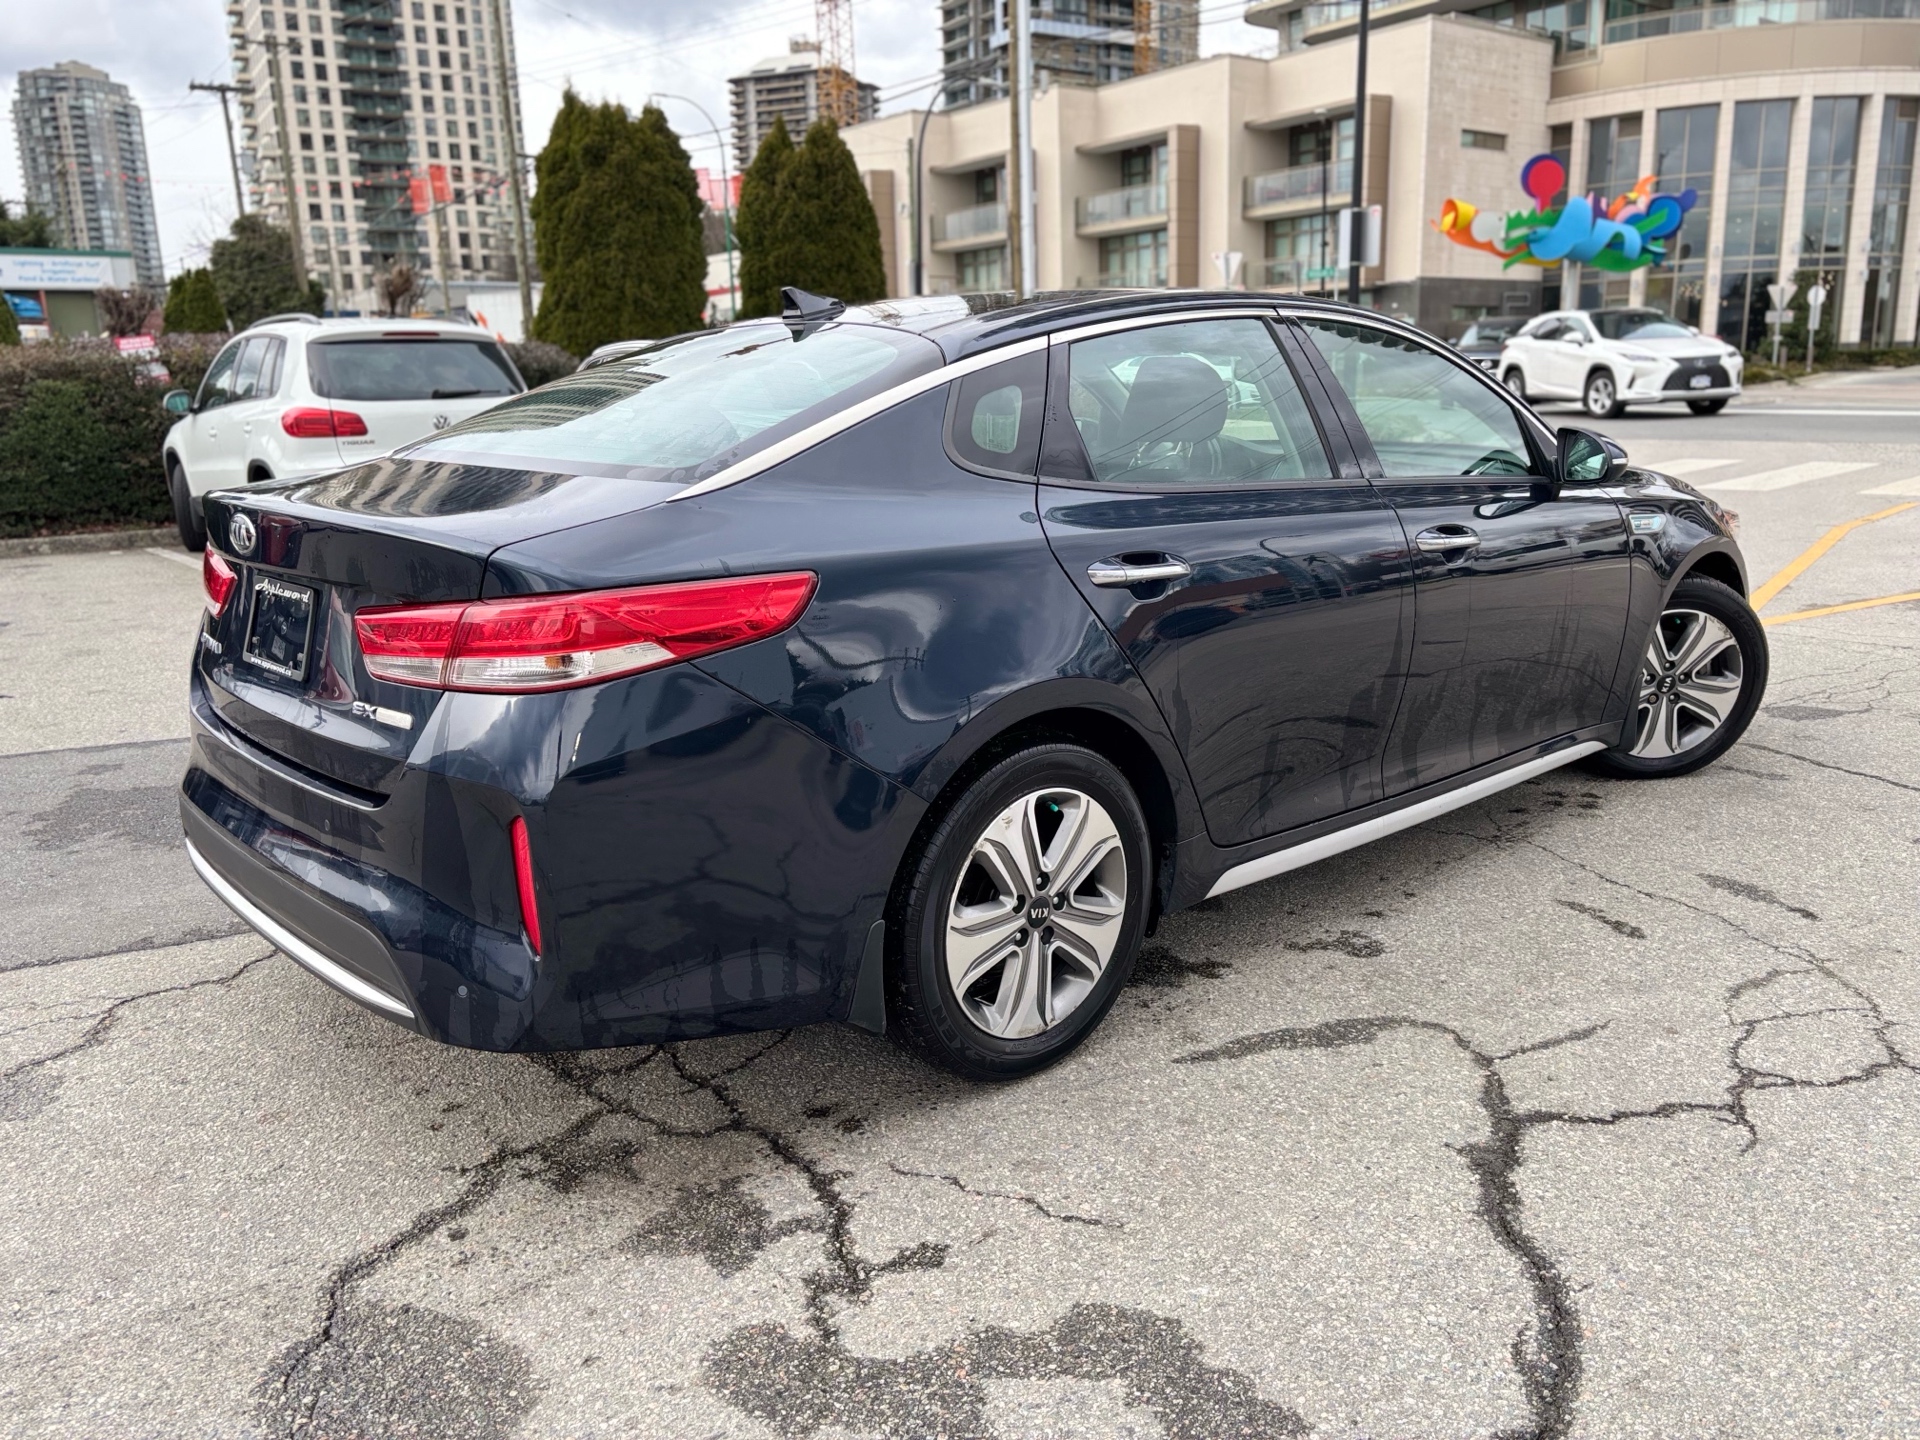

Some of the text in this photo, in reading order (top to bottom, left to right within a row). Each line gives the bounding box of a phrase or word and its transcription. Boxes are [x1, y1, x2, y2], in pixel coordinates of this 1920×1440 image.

[255, 579, 310, 602] Applewood
[1661, 677, 1672, 692] KIA
[352, 701, 377, 720] EX
[1030, 907, 1049, 919] KIA
